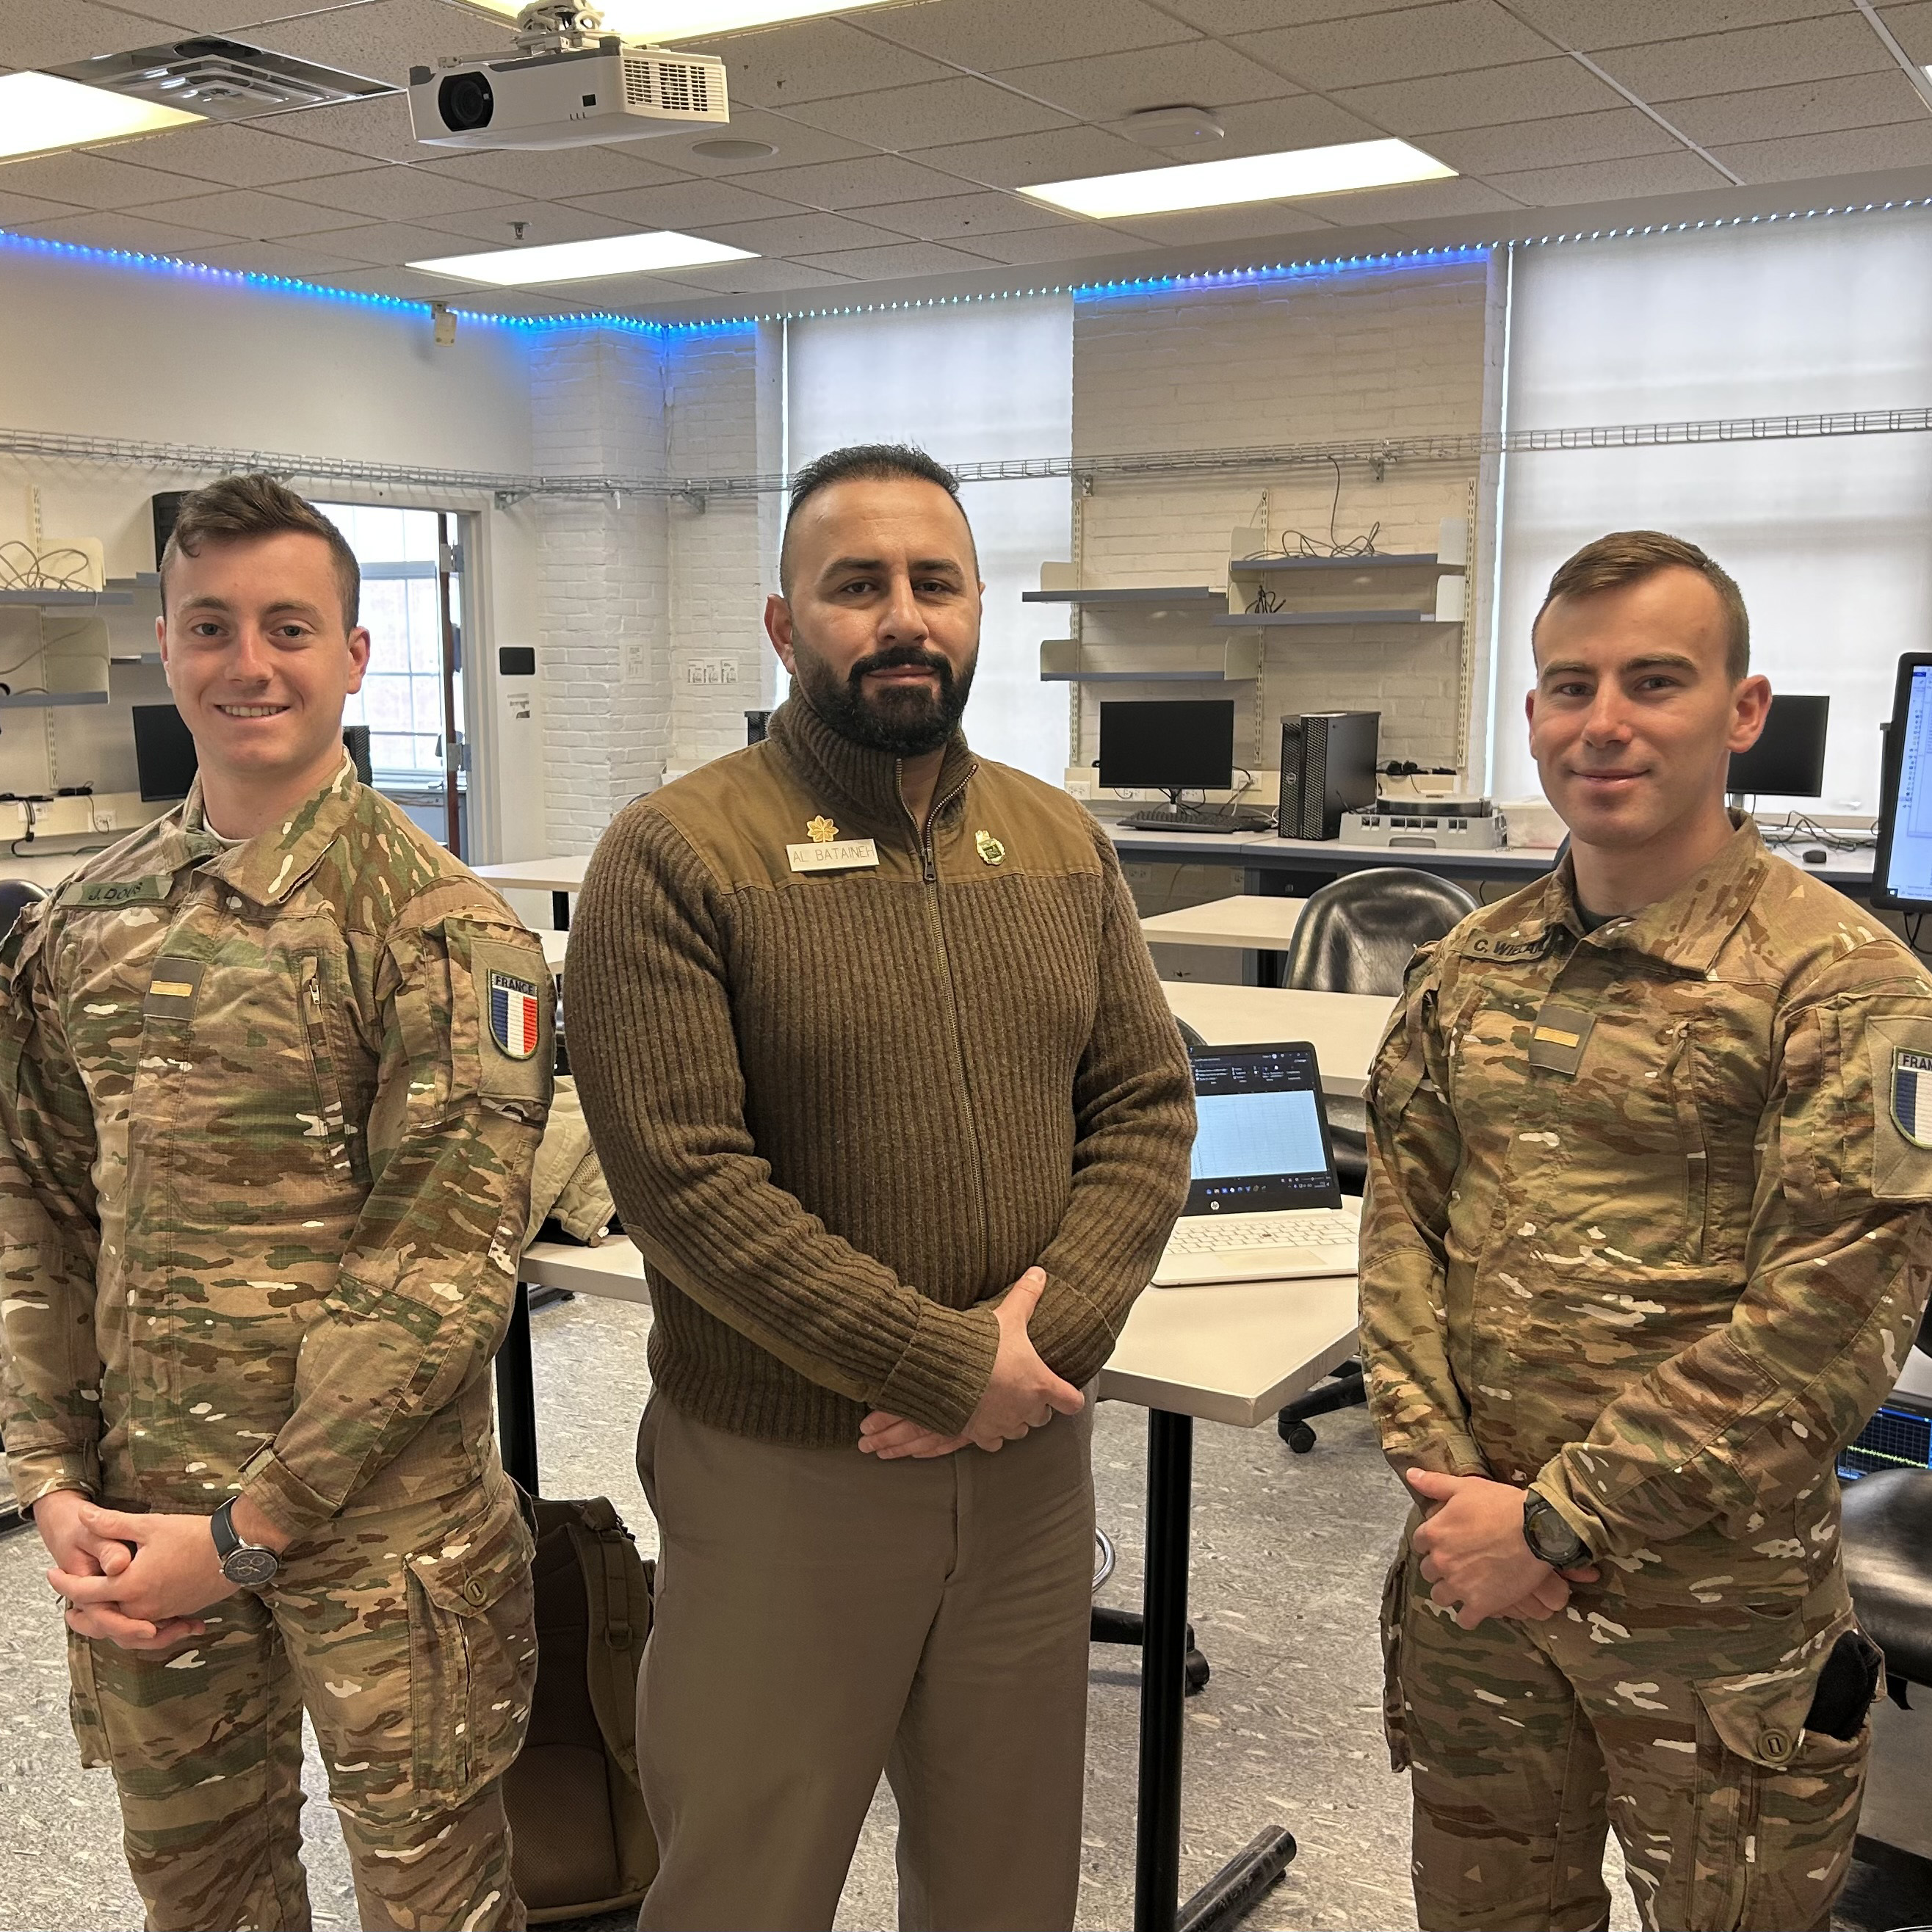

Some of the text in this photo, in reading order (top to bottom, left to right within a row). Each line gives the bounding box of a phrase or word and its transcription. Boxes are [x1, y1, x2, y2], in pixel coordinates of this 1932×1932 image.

[793, 845, 875, 863] AL BATAINEH
[496, 975, 534, 995] FRANCE
